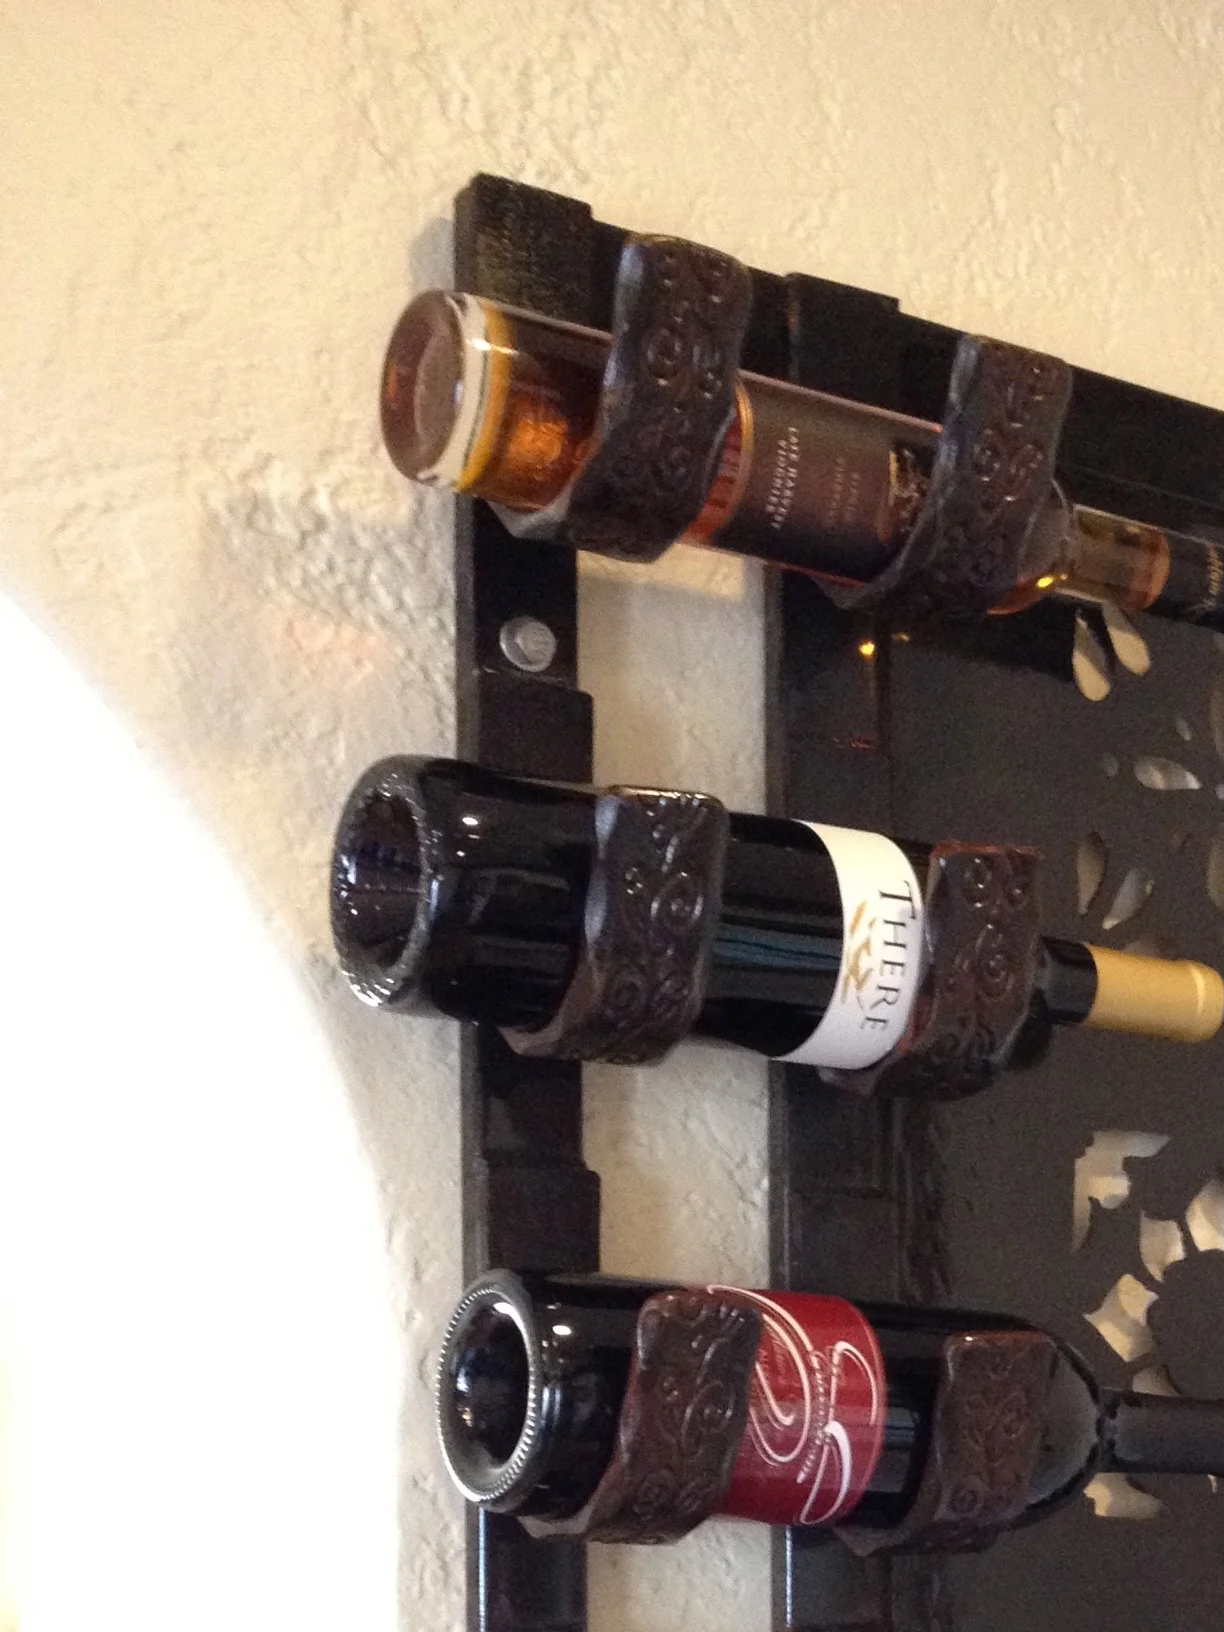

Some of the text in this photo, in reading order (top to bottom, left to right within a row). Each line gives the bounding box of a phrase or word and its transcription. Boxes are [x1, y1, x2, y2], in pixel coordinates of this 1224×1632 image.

[770, 426, 800, 530] LATE HARVEST
[859, 879, 917, 1032] THERE
